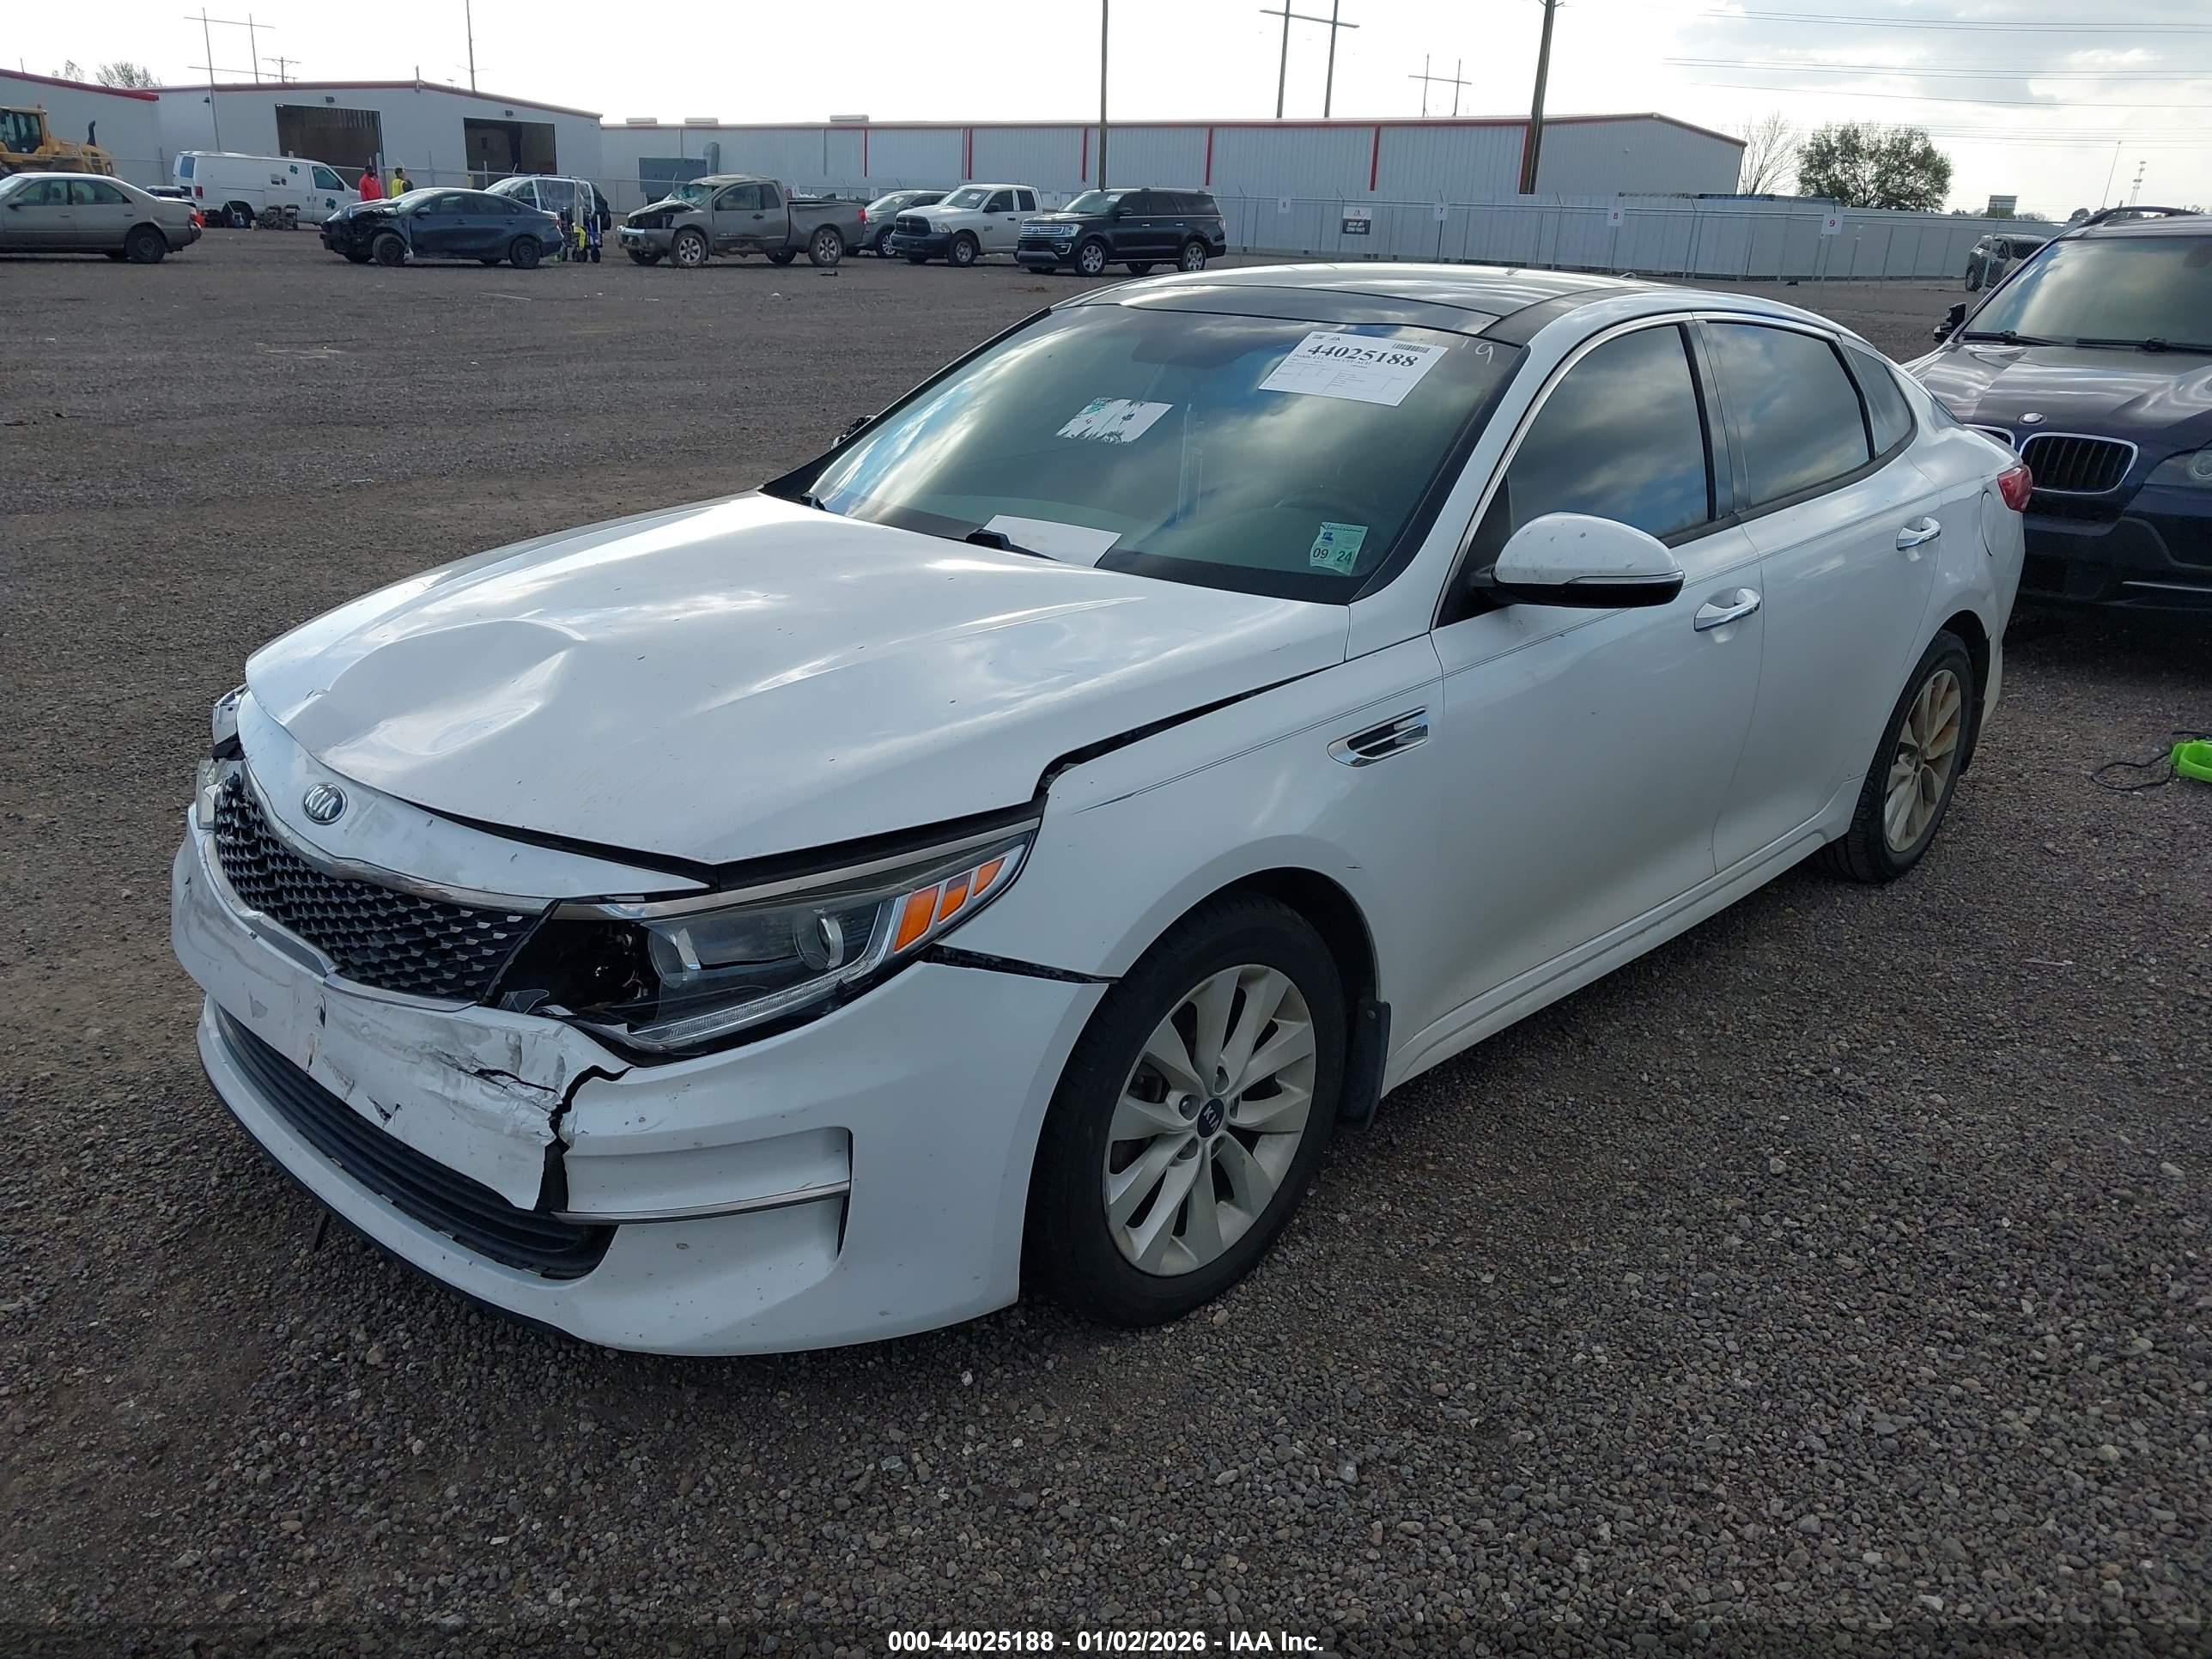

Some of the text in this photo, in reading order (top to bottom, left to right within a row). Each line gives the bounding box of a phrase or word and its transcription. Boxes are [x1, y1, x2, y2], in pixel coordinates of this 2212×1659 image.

[1307, 343, 1419, 368] 44025188
[1313, 548, 1353, 565] 09 24
[1203, 1104, 1220, 1133] KIA
